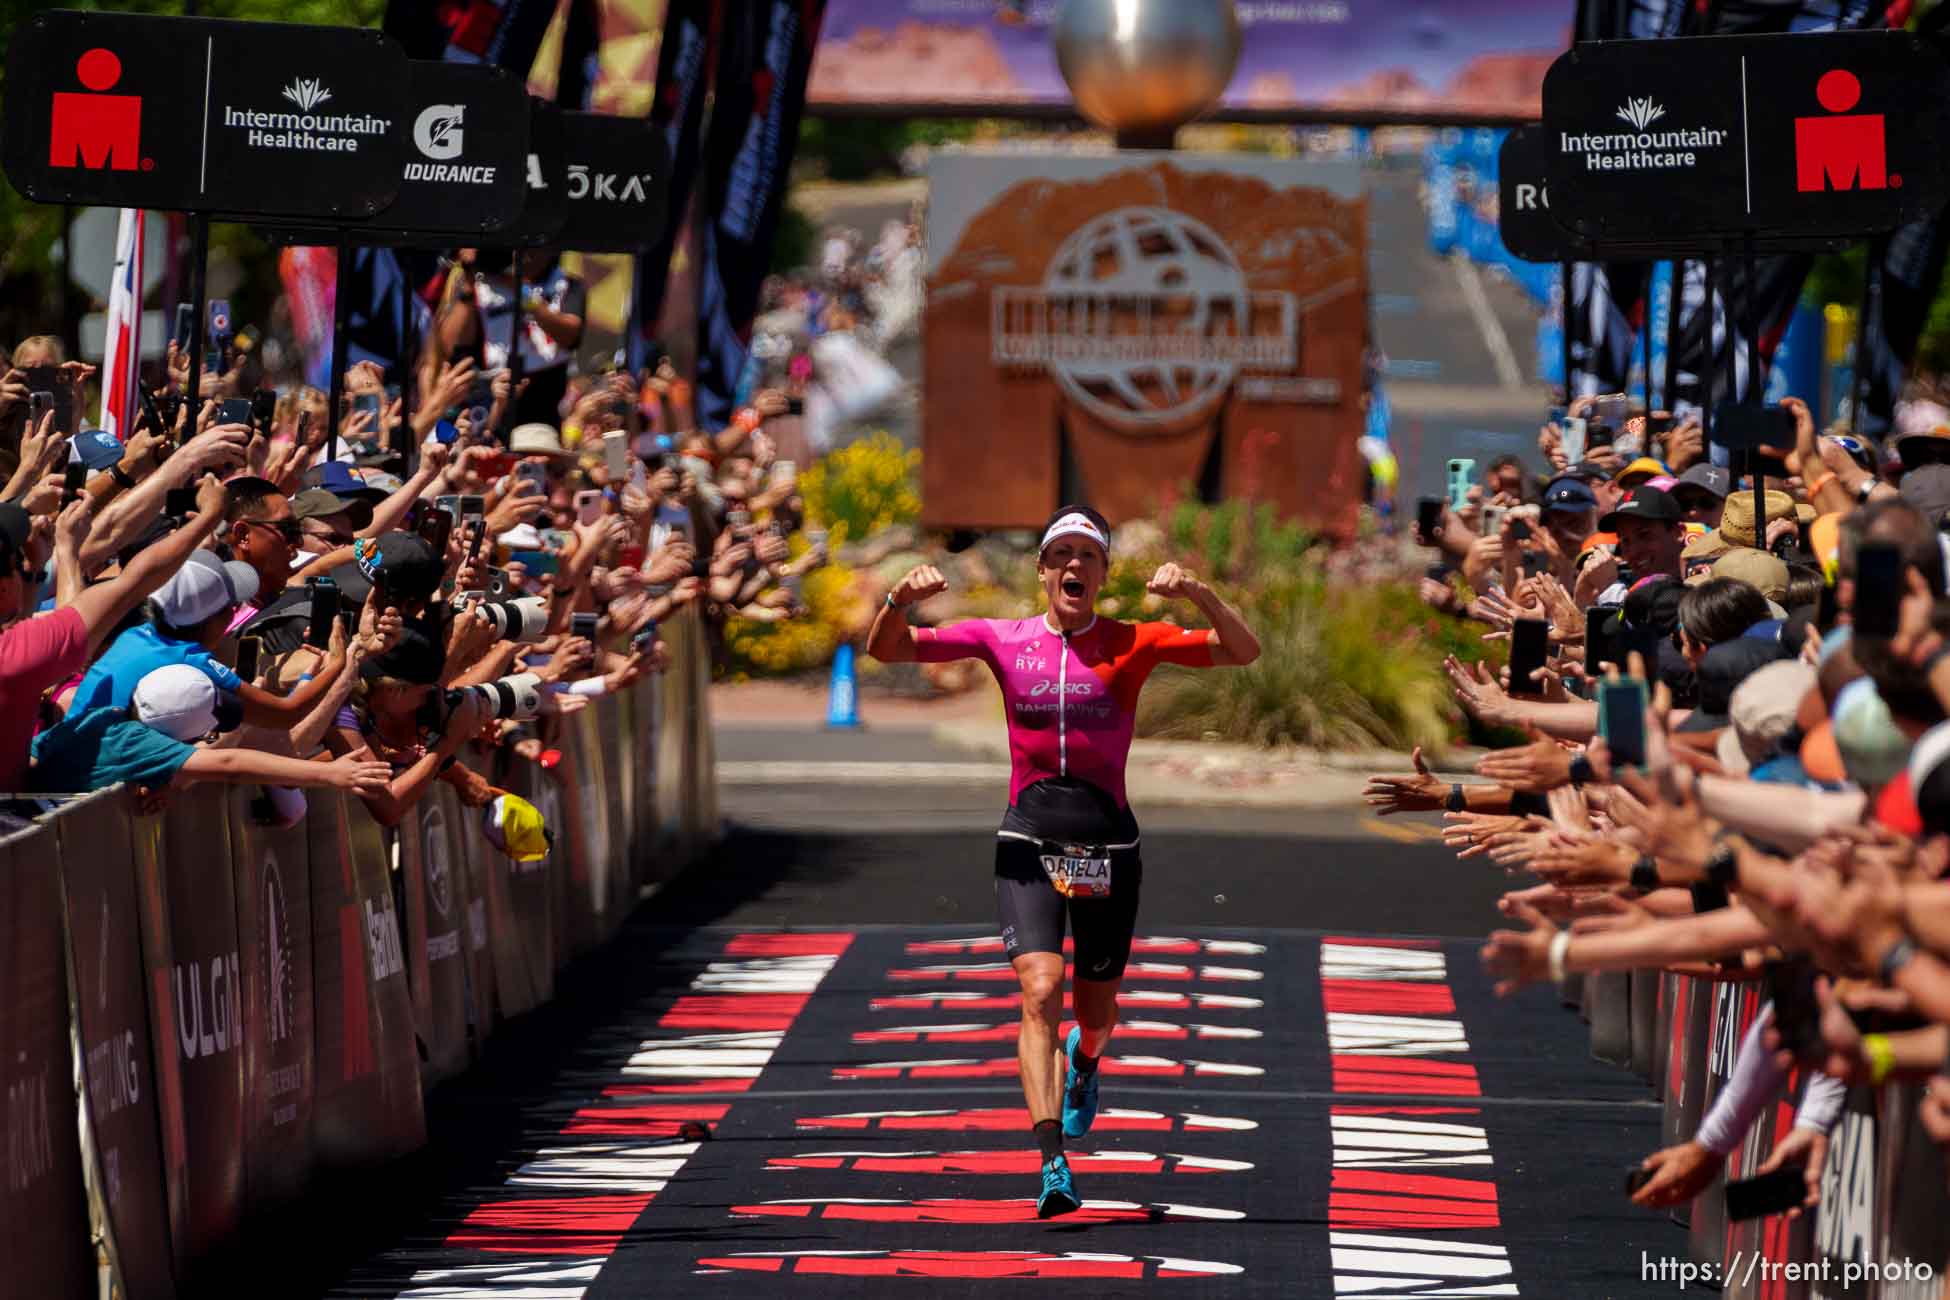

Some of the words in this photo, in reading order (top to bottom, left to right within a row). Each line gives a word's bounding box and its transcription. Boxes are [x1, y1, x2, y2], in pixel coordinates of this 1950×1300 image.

[224, 105, 386, 134] Intermountain
[248, 129, 358, 151] Healthcare
[1560, 126, 1722, 152] Intermountain
[1586, 150, 1696, 170] Healthcare
